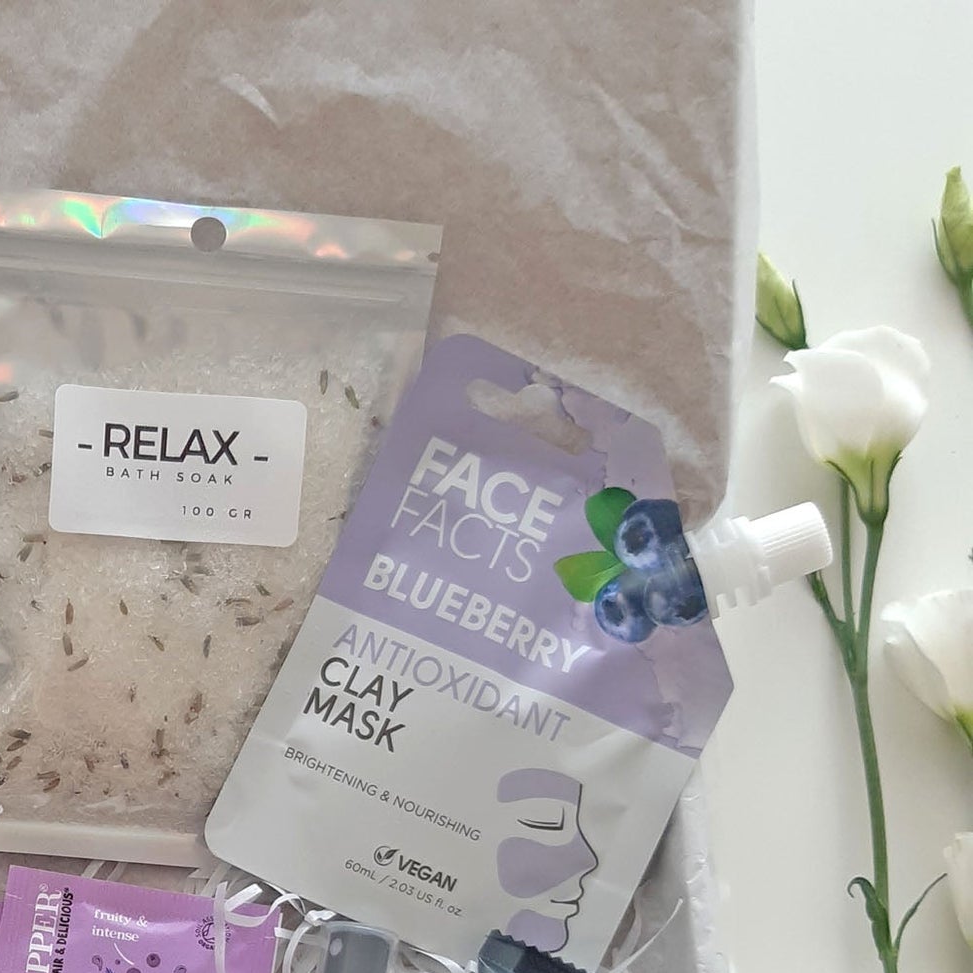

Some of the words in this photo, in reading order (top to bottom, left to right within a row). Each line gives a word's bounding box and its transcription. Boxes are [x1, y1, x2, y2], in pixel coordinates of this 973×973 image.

[103, 422, 241, 466] RELAX
[105, 466, 161, 482] BATH
[176, 472, 233, 486] SOAK
[409, 436, 563, 543] FACE
[181, 505, 215, 518] 100
[229, 508, 253, 520] GR
[391, 486, 541, 583] FACTS
[363, 553, 593, 674] BLUEBERRY
[320, 656, 415, 712] CLAY
[333, 624, 571, 742] ANTIOXIDANT
[303, 686, 406, 752] MASK
[284, 747, 377, 796] BRIGHTENING
[379, 790, 391, 802] &
[393, 796, 481, 841] NOURISHING
[345, 859, 377, 880] 60mL
[389, 878, 415, 896] 2.03
[417, 890, 433, 904] US
[398, 855, 457, 892] VEGAN
[91, 925, 139, 942] intense
[93, 908, 131, 925] fruity
[136, 916, 147, 928] &
[55, 947, 65, 955] &
